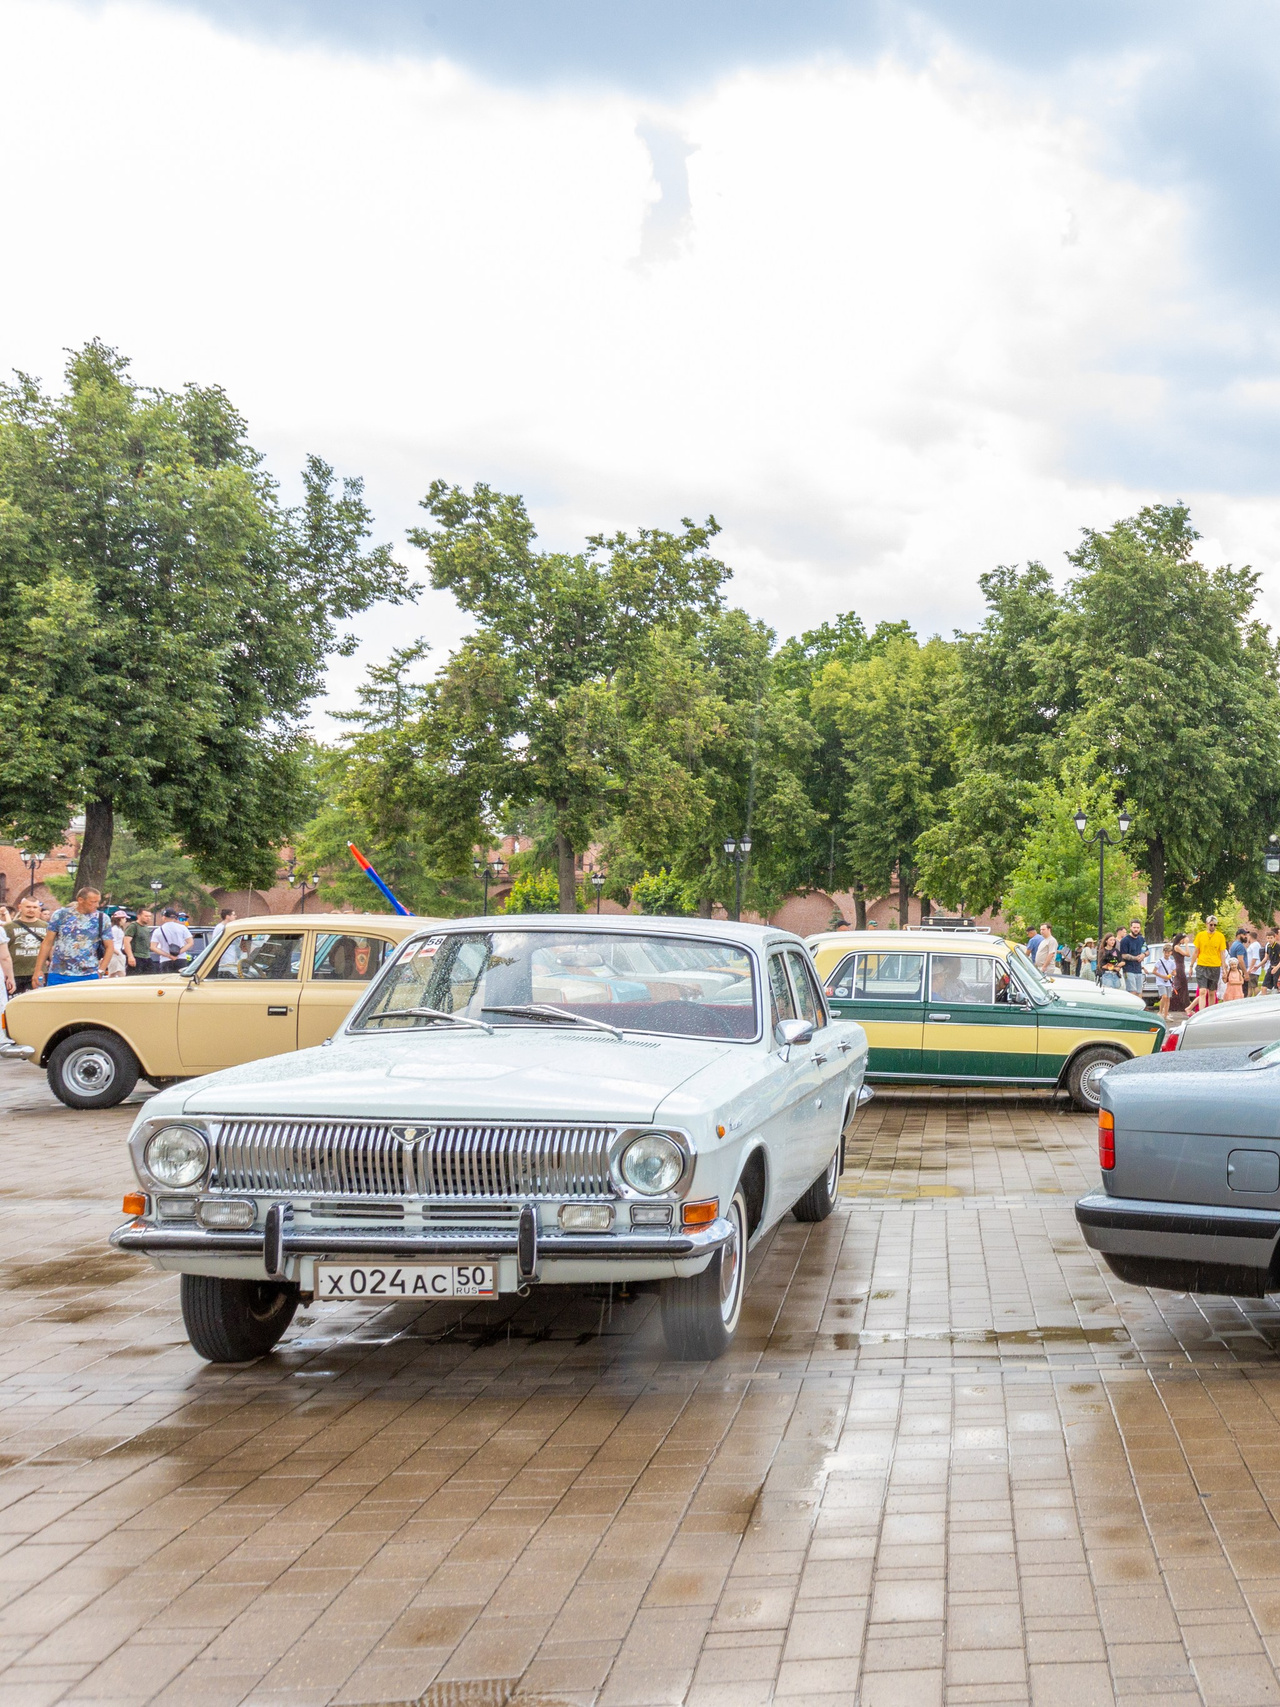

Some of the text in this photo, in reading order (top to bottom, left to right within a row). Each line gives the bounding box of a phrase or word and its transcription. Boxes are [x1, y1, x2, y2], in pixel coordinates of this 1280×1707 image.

[426, 938, 444, 946] 58
[456, 1266, 486, 1286] 50
[456, 1287, 478, 1295] RUS
